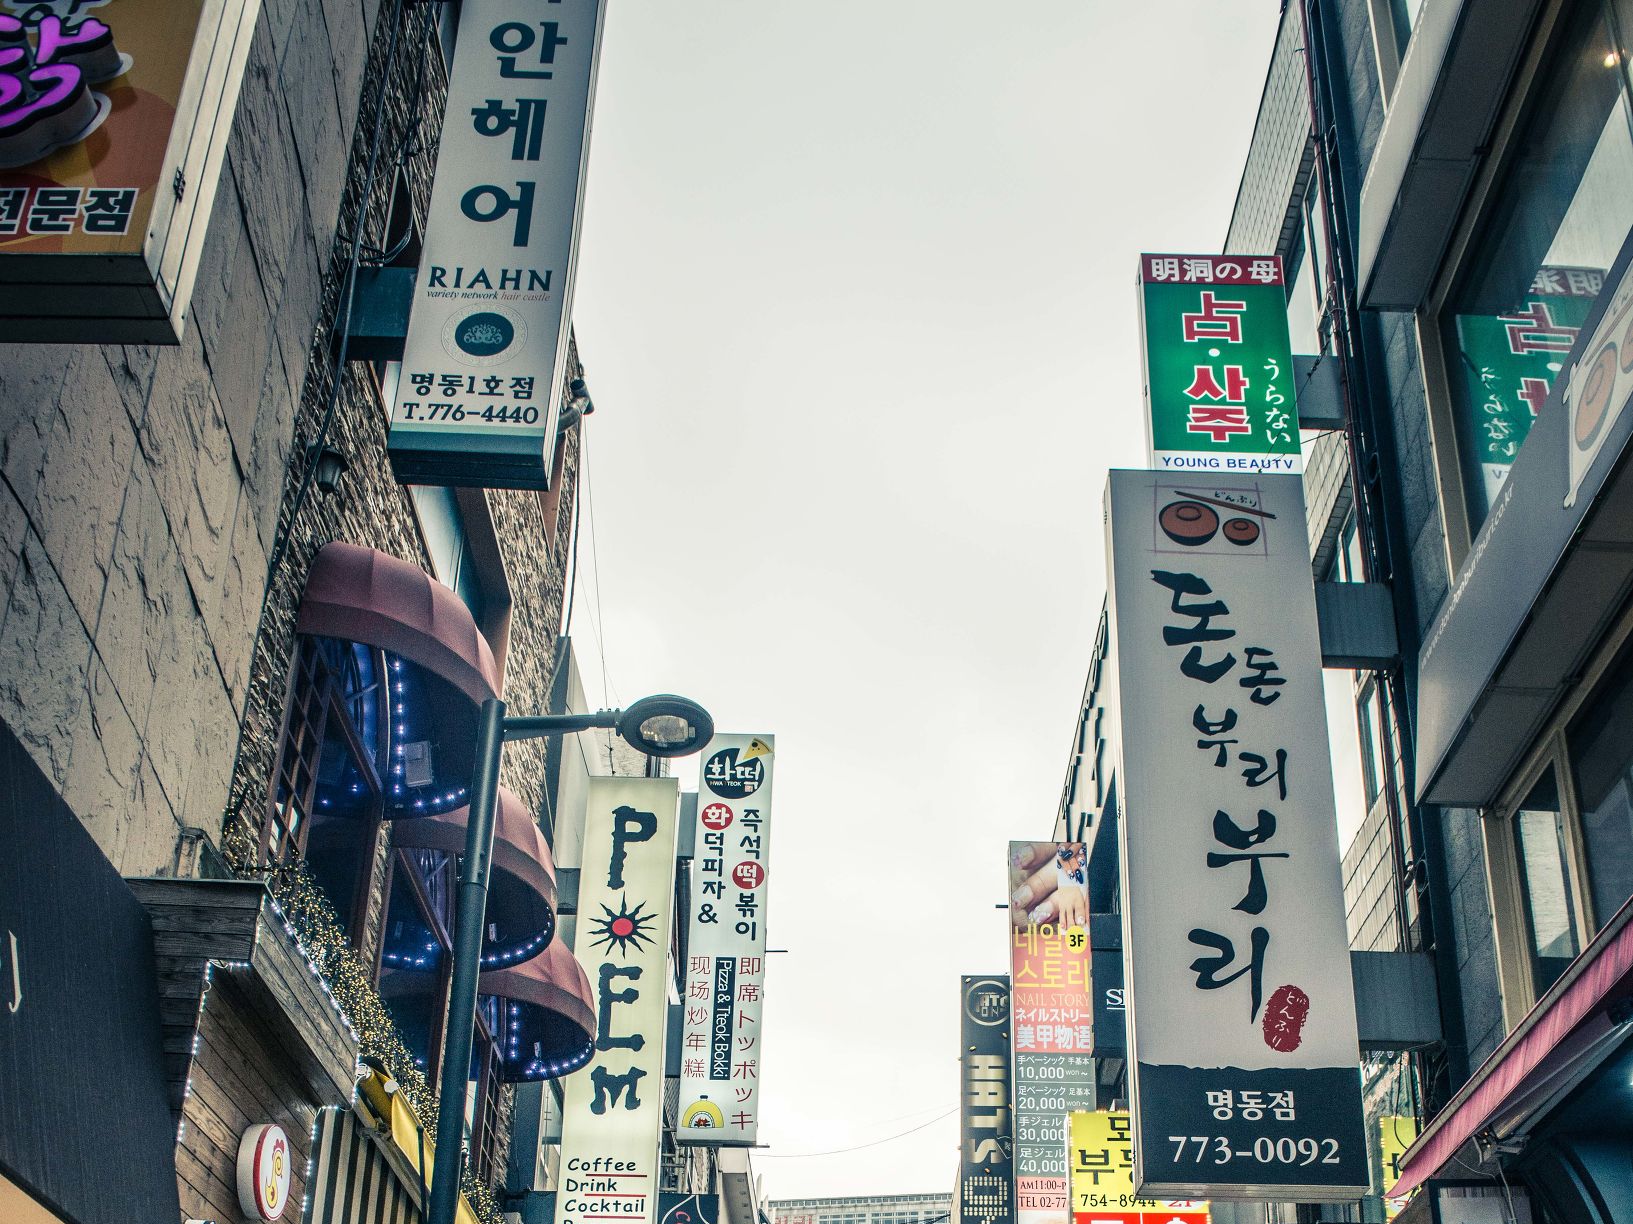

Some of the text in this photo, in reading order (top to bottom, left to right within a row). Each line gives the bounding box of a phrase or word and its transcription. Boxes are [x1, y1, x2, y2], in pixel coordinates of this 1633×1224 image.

[460, 0, 567, 247] 안헤어
[1151, 258, 1279, 283] 明洞の母
[428, 266, 552, 291] RIAHN
[427, 290, 550, 301] variety network hair castle
[411, 373, 534, 399] 명동1호점
[1263, 358, 1292, 444] うらない
[403, 403, 539, 424] T.776-4440
[1162, 457, 1220, 469] YOUNG
[707, 756, 761, 789] 화떡
[735, 809, 762, 940] 즉석떡볶이
[1015, 923, 1063, 957] 네일
[1069, 935, 1084, 947] 3F
[717, 960, 733, 992] Pizza
[1014, 958, 1090, 992] 스토리
[720, 995, 731, 1005] &
[1017, 993, 1090, 1007] NAIL STORY
[684, 956, 711, 1078] 现场炒年糕
[1015, 1008, 1090, 1022] ネイルストリー
[731, 956, 760, 1131] 即席トッポッキ
[1017, 1024, 1091, 1049] 美甲物语
[714, 1041, 729, 1078] Bokki
[1018, 1055, 1090, 1065] 手ベーシック 手基本
[1018, 1066, 1065, 1081] 10,000
[1018, 1086, 1090, 1096] 足ベーシック 足基本
[1019, 1098, 1065, 1111] 20,000
[1206, 1090, 1296, 1121] 명동점
[1019, 1117, 1061, 1126] 手ジェル
[1019, 1128, 1065, 1141] 30,000
[1020, 1148, 1064, 1158] 足ジェル
[1169, 1136, 1340, 1165] 773-0092
[568, 1158, 636, 1172] Coffee
[1020, 1160, 1066, 1173] 40,000
[566, 1178, 617, 1192] Drink
[565, 1199, 645, 1213] Cocktail
[1019, 1196, 1038, 1207] TEL
